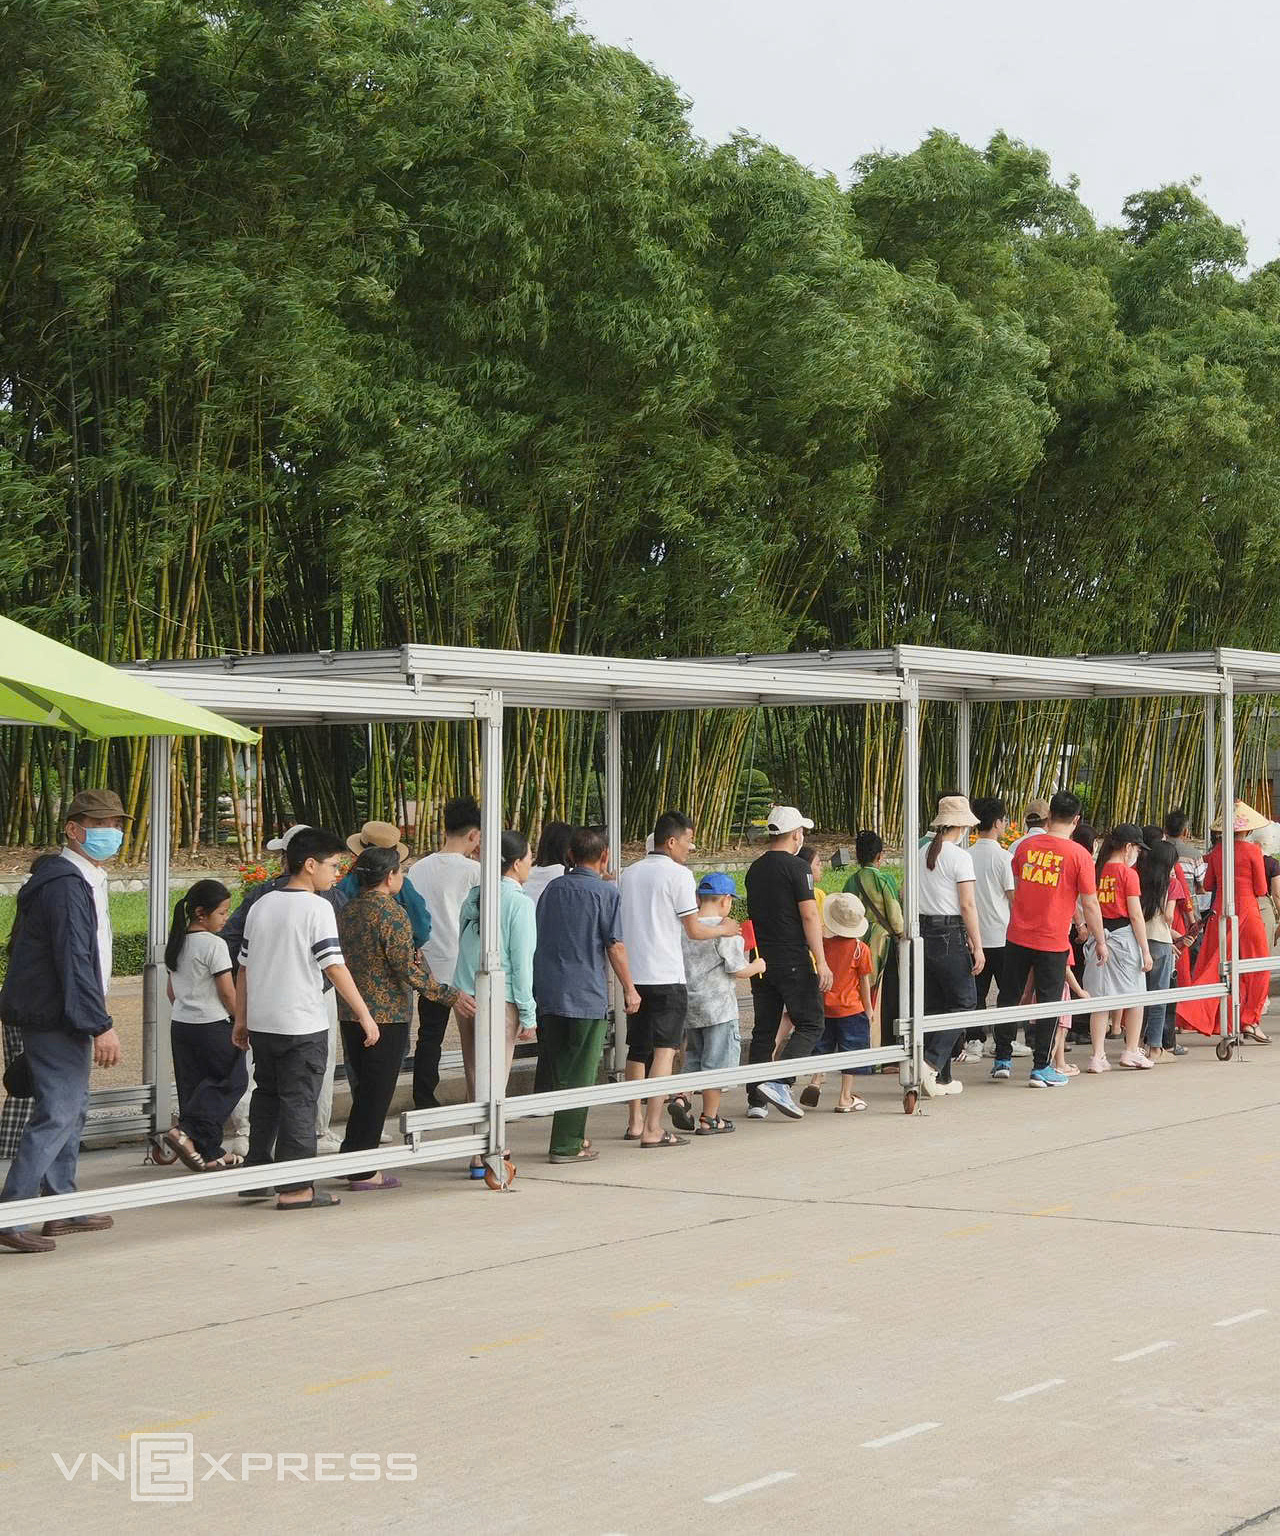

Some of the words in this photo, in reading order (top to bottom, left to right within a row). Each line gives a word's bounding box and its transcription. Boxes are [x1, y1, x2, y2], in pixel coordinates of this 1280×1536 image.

[1027, 850, 1064, 872] VIỆT
[1022, 862, 1059, 887] NAM
[1100, 874, 1116, 891] IỆT
[1098, 891, 1115, 903] AM
